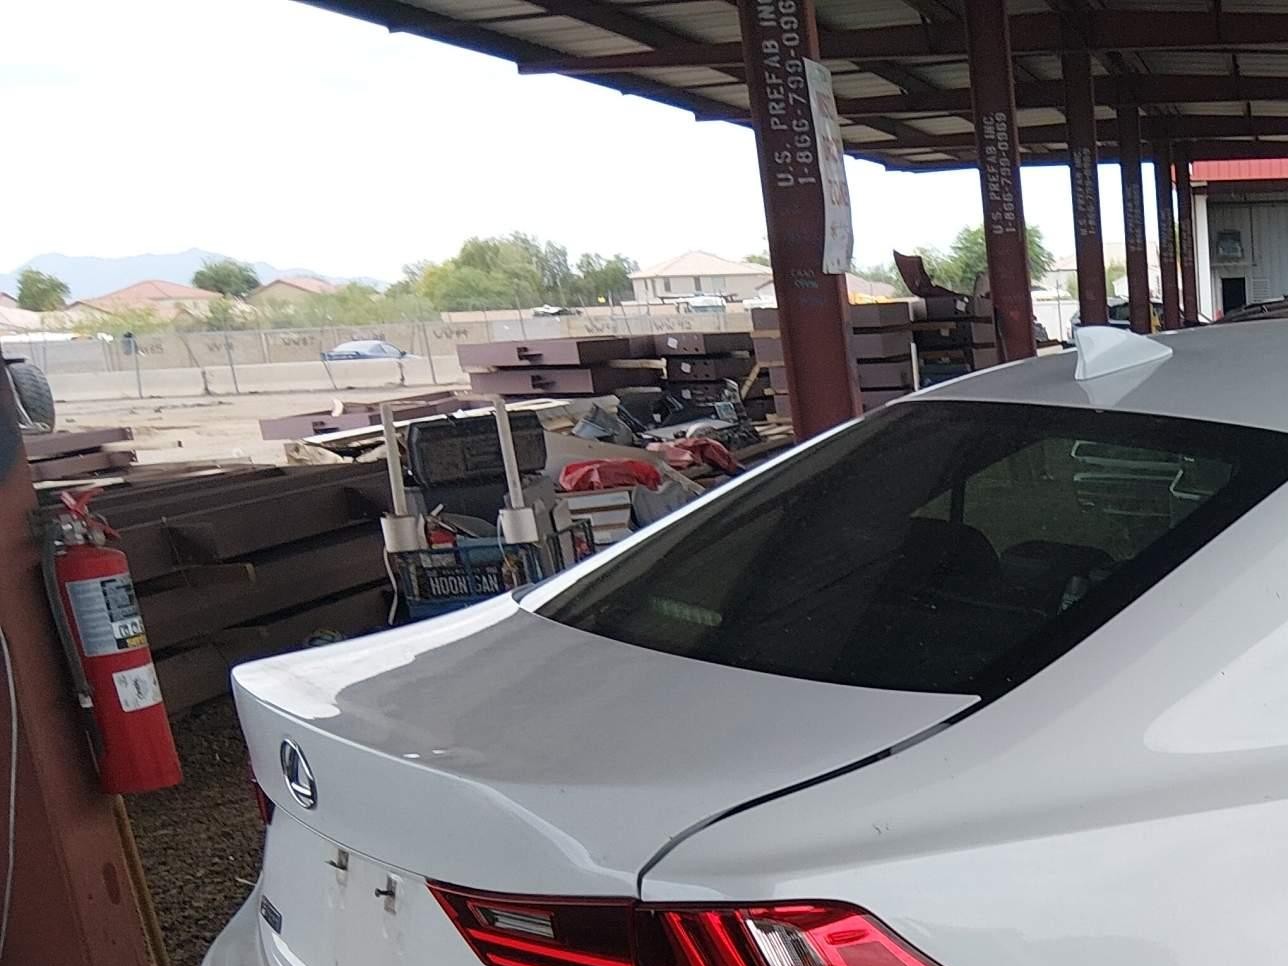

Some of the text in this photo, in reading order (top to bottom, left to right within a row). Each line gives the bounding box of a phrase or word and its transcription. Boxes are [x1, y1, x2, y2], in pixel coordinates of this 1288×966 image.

[762, 39, 789, 131] PREFAB
[775, 143, 795, 187] U.S.
[985, 145, 1001, 201] PREFAB
